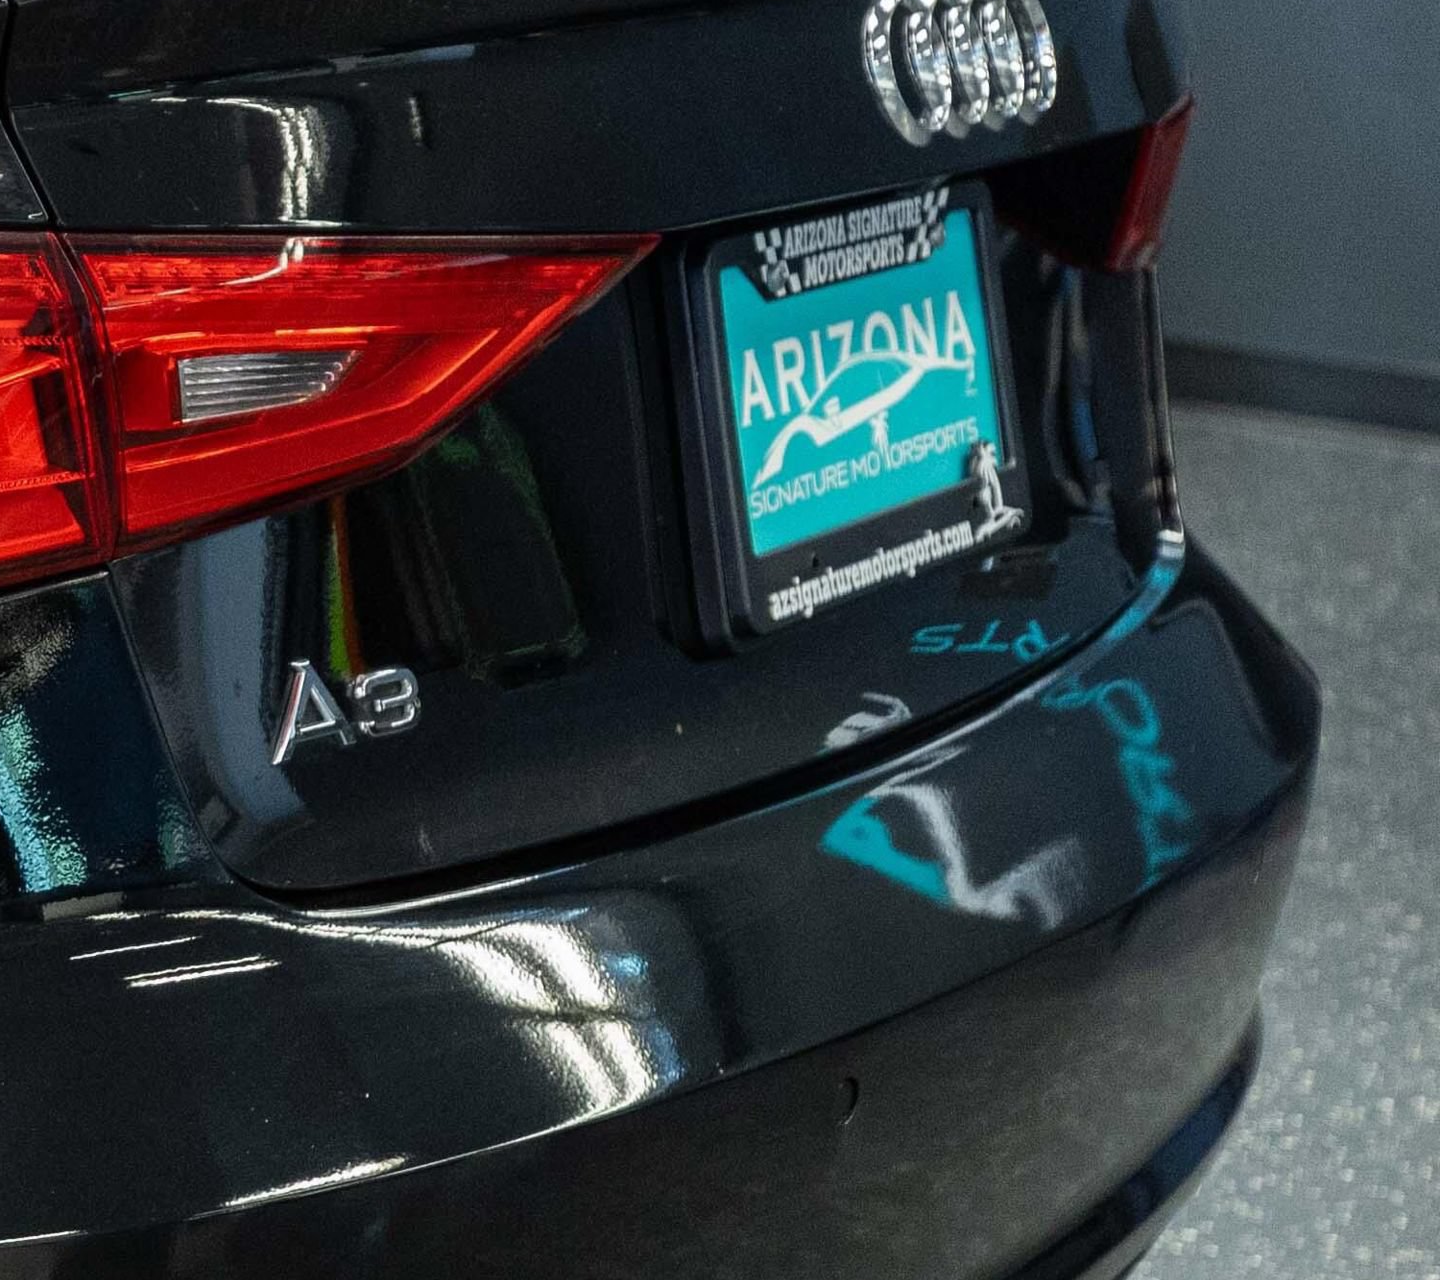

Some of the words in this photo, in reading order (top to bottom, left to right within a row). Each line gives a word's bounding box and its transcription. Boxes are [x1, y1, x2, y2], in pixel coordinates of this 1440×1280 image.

[783, 215, 847, 260] ARIZONA
[848, 195, 923, 242] SIGNATURE
[803, 233, 905, 288] MOTORSPORTS
[741, 290, 977, 427] ARIZONA
[749, 460, 849, 519] SIGNATURE
[851, 416, 980, 483] MOTORSPORTS
[768, 521, 975, 621] azsignaturemotorsports.com
[272, 658, 422, 766] A3
